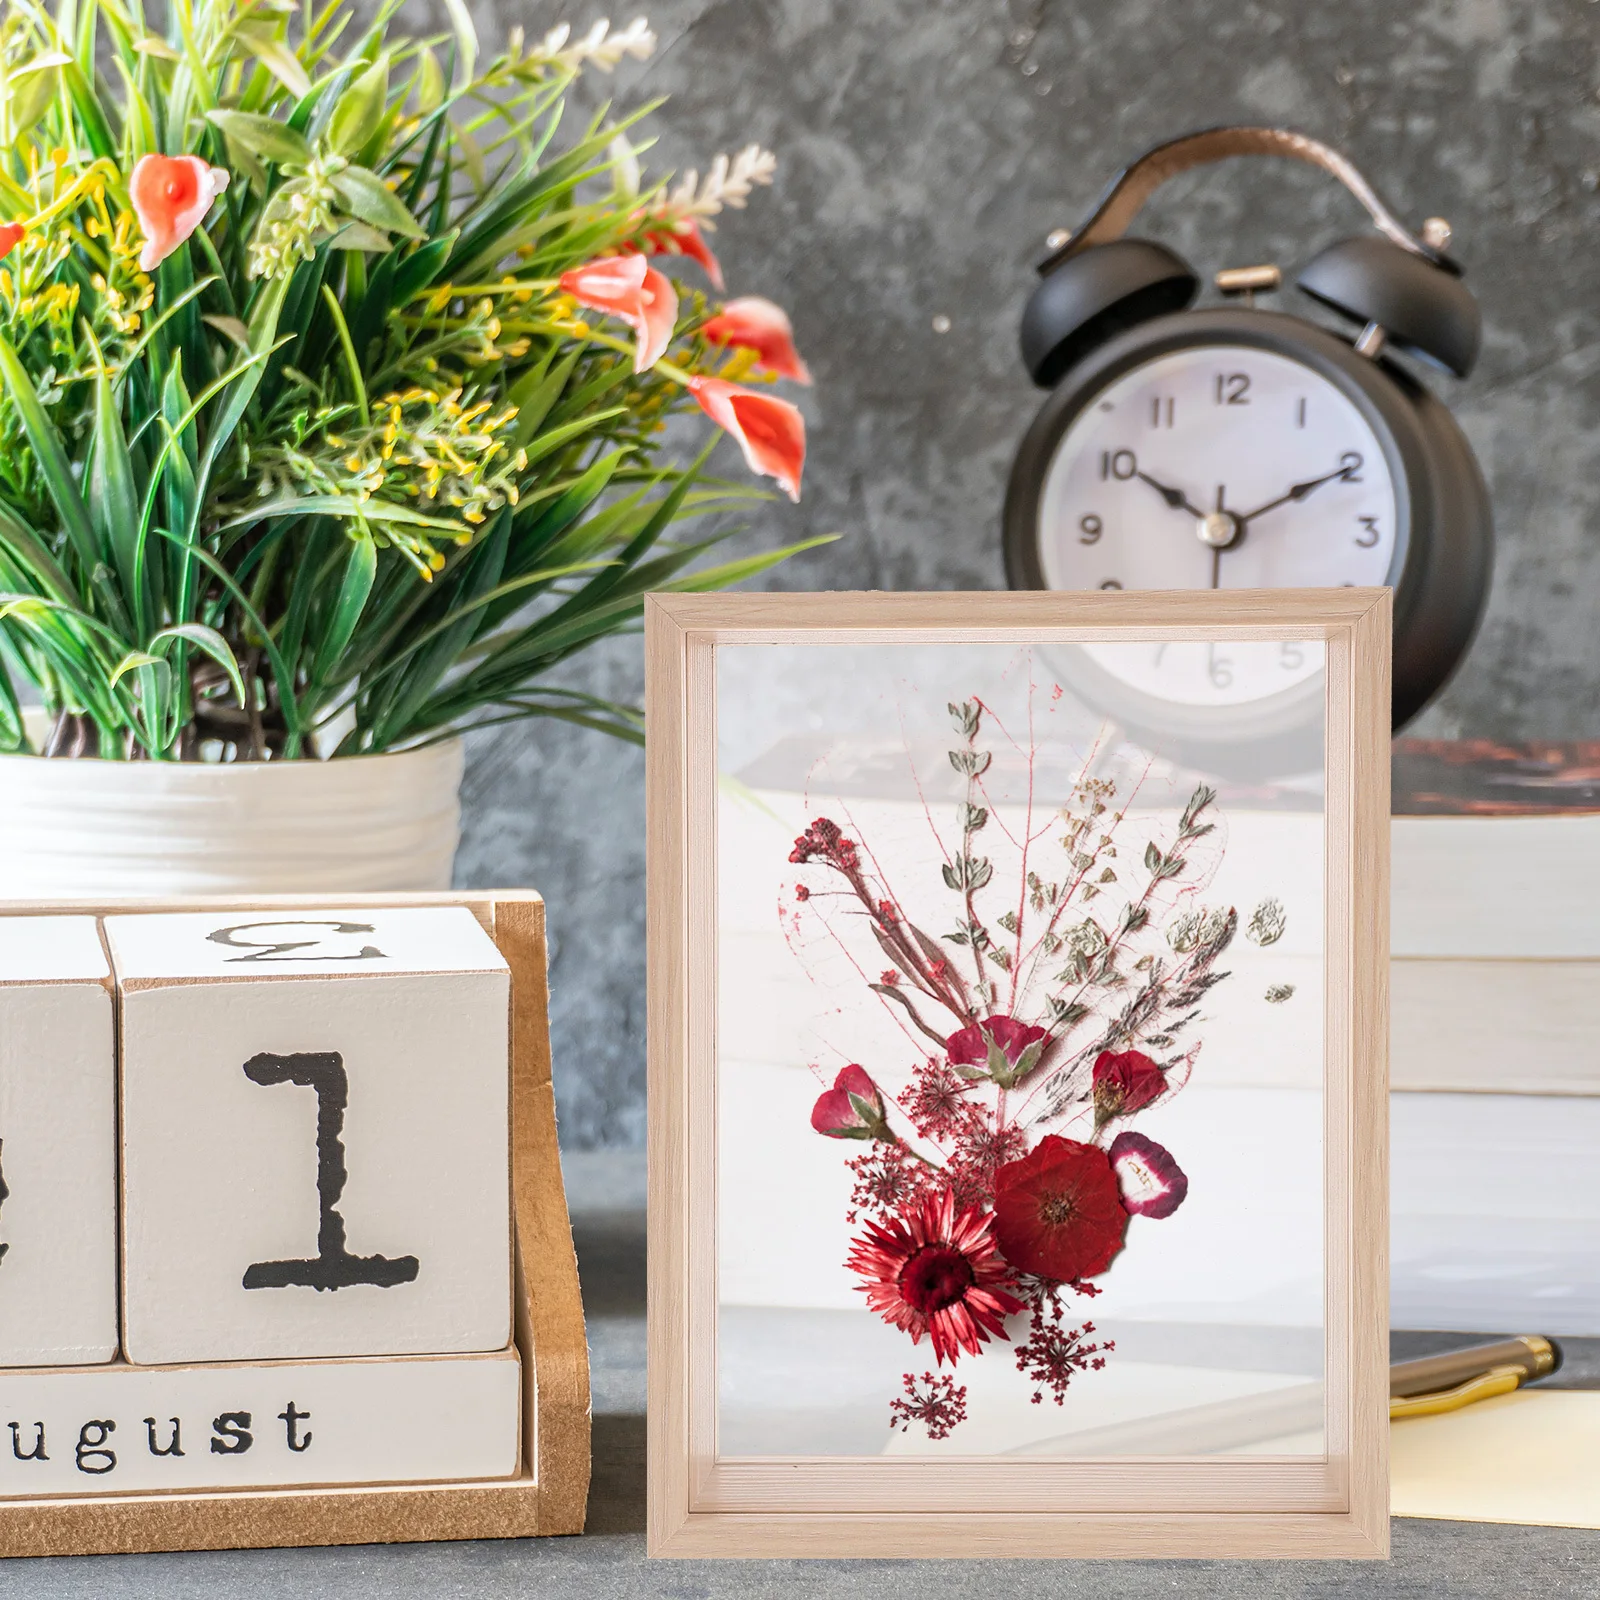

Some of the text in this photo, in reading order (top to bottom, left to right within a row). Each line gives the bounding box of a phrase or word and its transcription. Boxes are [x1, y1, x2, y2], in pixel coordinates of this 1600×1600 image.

[1214, 372, 1251, 405] 12
[1151, 396, 1175, 429] 11
[1296, 397, 1306, 429] 1
[1101, 448, 1138, 482] 10
[1339, 451, 1364, 483] 2
[1079, 514, 1103, 546] 9
[1355, 516, 1380, 549] 3
[1211, 658, 1234, 690] 6
[242, 1051, 420, 1293] 1
[7, 1401, 313, 1475] ugust
